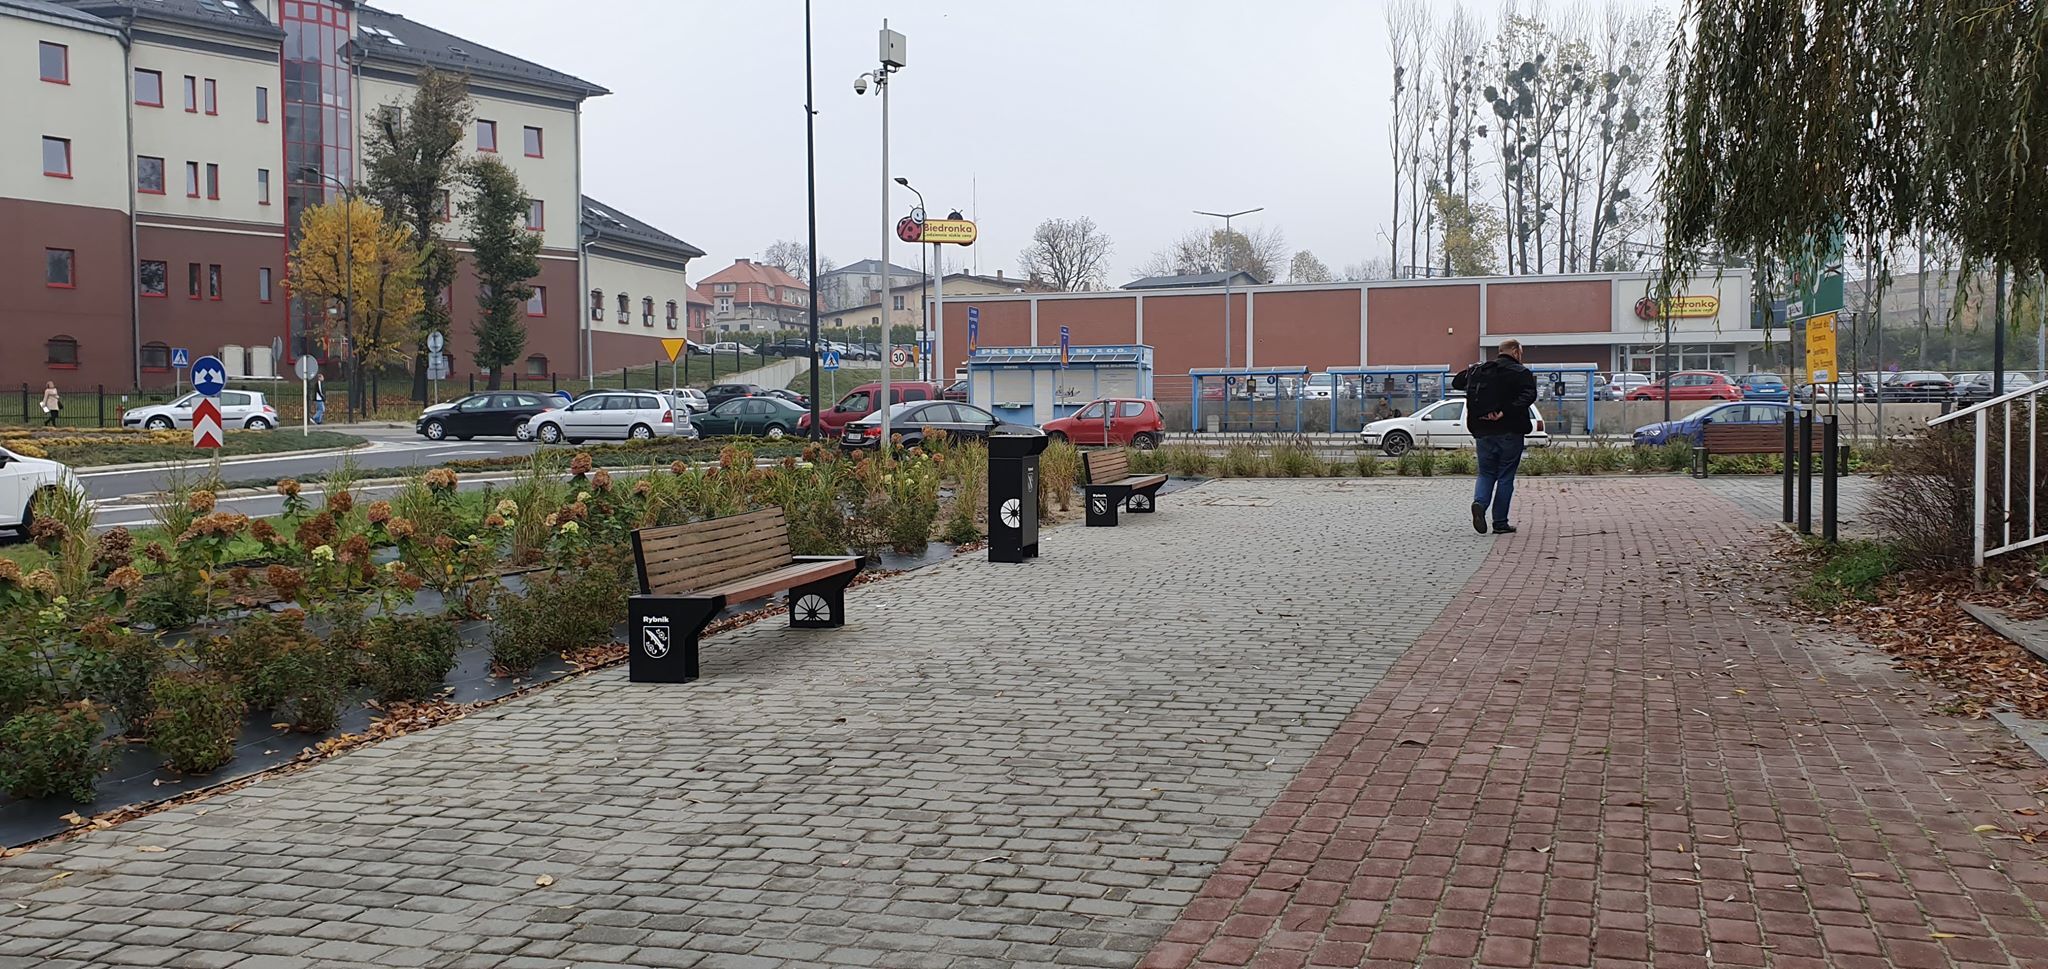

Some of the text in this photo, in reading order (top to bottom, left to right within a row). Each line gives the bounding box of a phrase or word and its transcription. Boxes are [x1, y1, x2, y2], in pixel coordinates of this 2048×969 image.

[923, 223, 972, 233] Biedronka
[893, 352, 904, 362] 30
[643, 616, 669, 624] Rybnik
